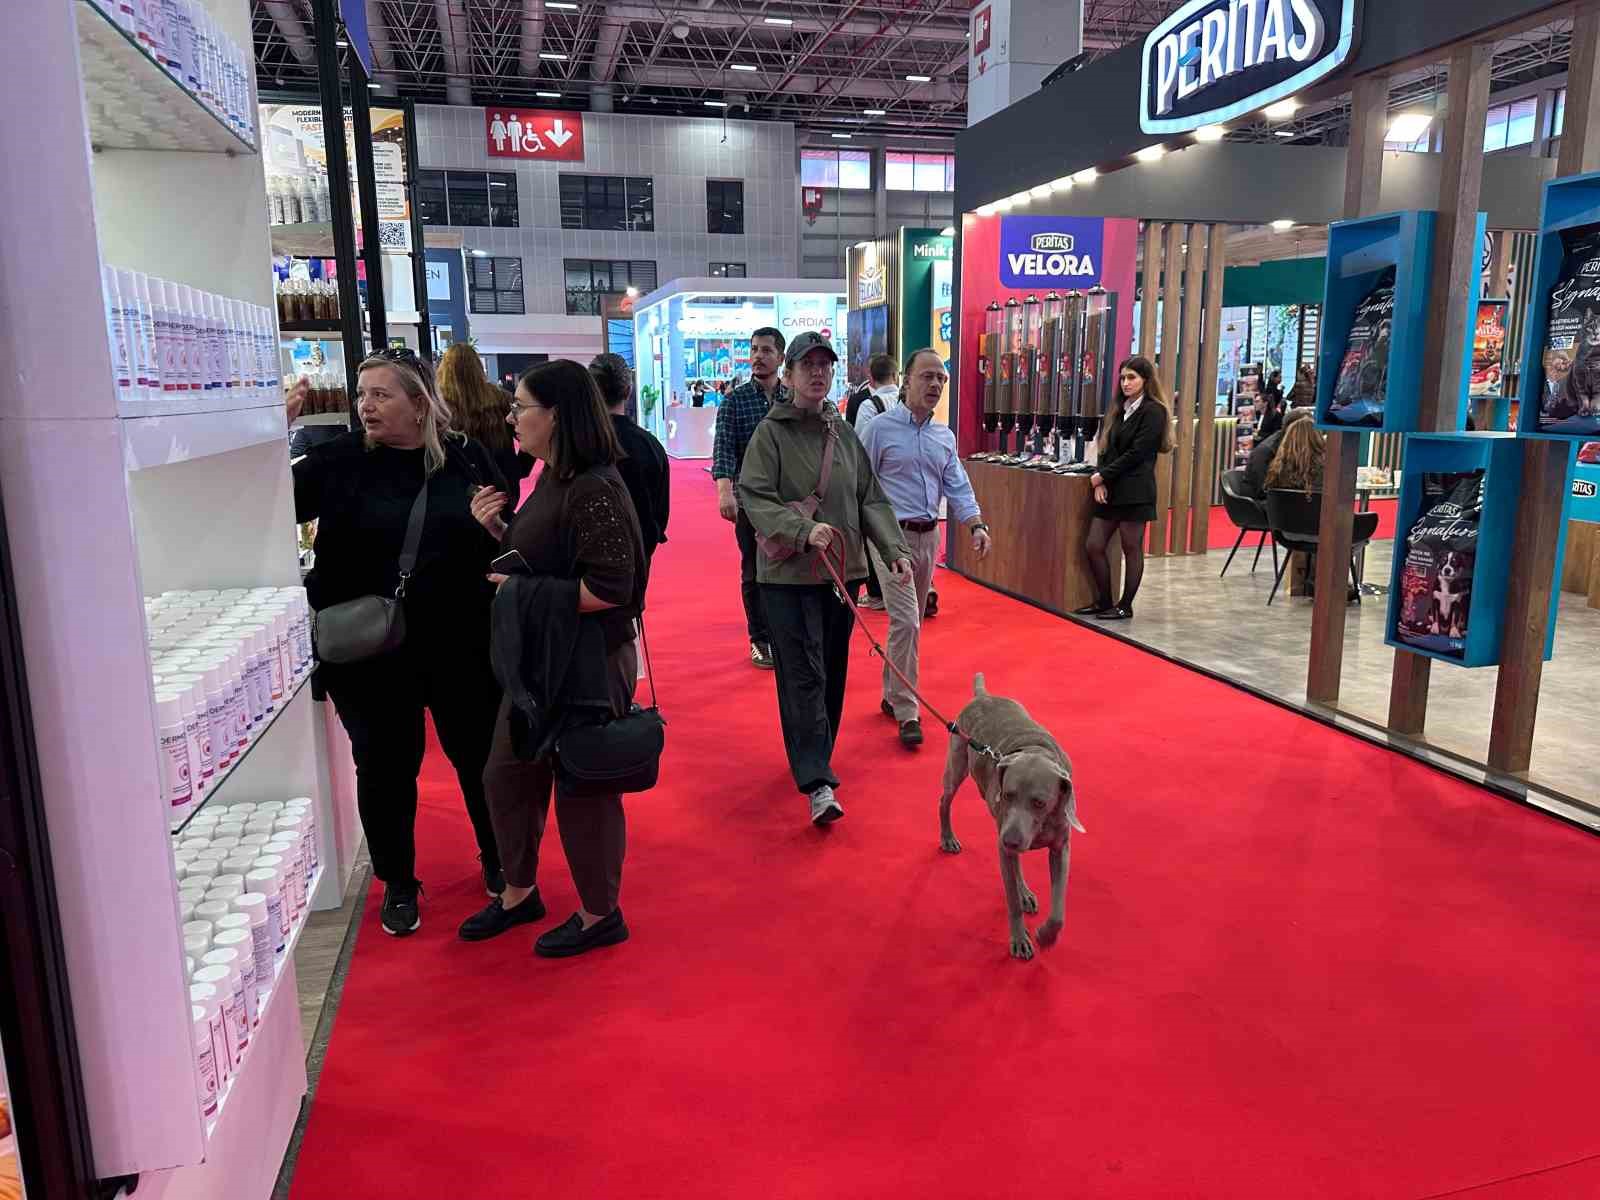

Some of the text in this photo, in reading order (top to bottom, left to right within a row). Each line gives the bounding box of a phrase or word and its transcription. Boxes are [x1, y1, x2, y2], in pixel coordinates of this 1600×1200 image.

[1035, 236, 1070, 250] PERITAS
[1007, 253, 1095, 276] VELORA
[782, 317, 833, 328] CARDIAC
